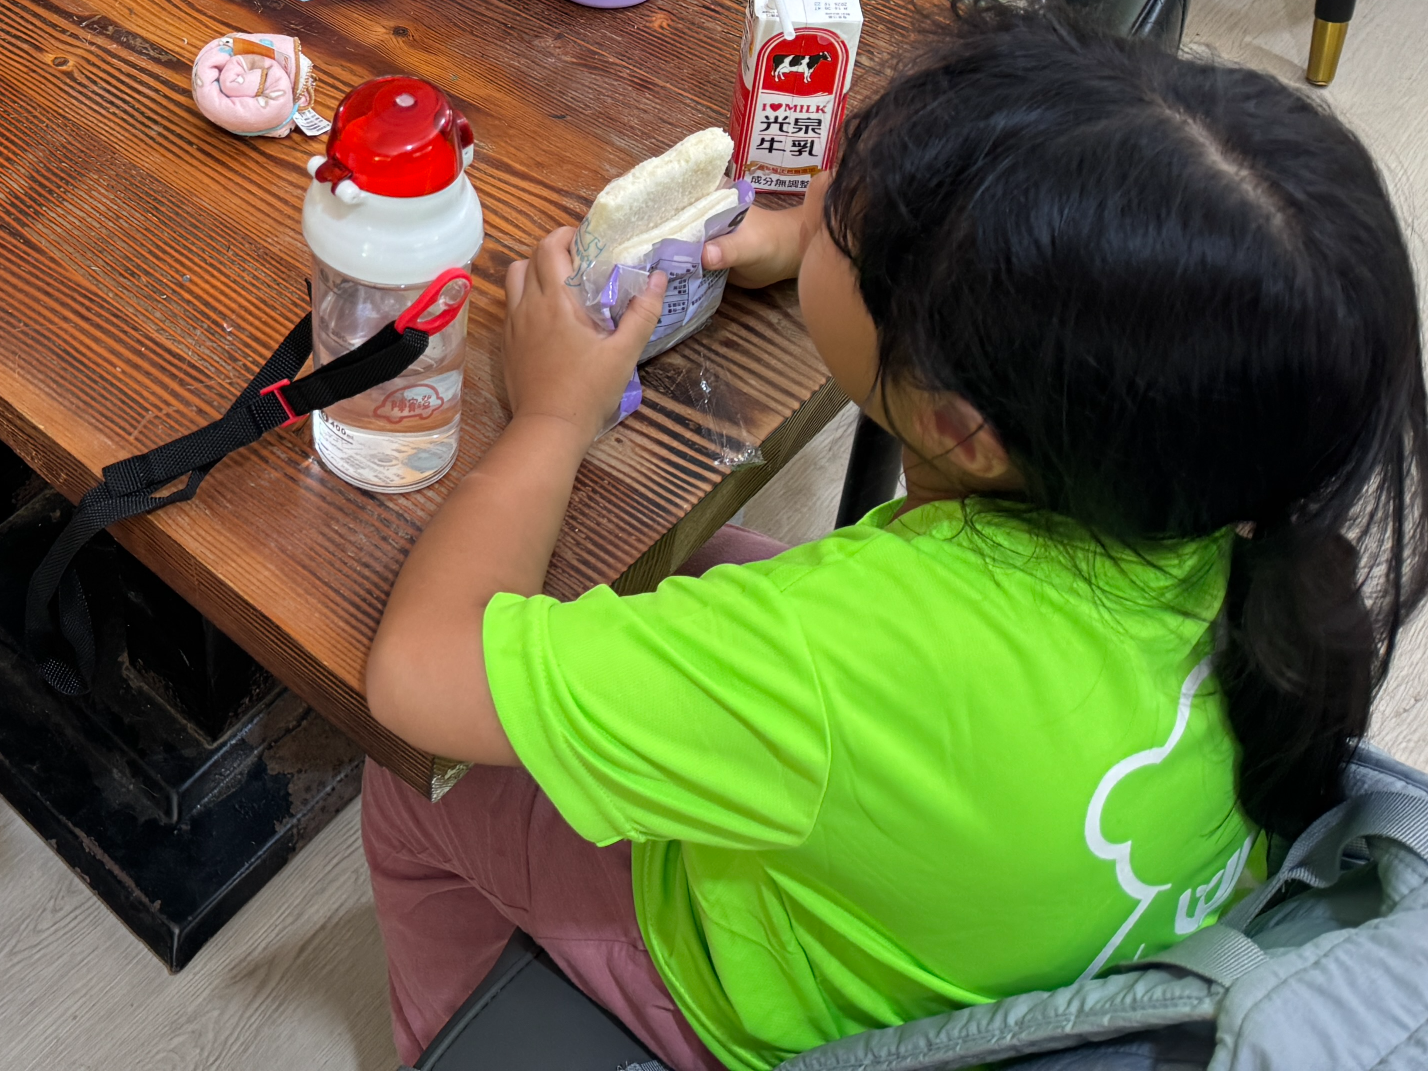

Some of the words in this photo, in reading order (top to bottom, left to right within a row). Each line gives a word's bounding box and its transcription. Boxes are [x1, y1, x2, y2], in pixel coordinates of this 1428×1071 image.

[784, 103, 828, 114] MILK
[759, 115, 822, 135] 光泉
[756, 137, 819, 157] 牛乳
[750, 176, 810, 189] 成分無調整
